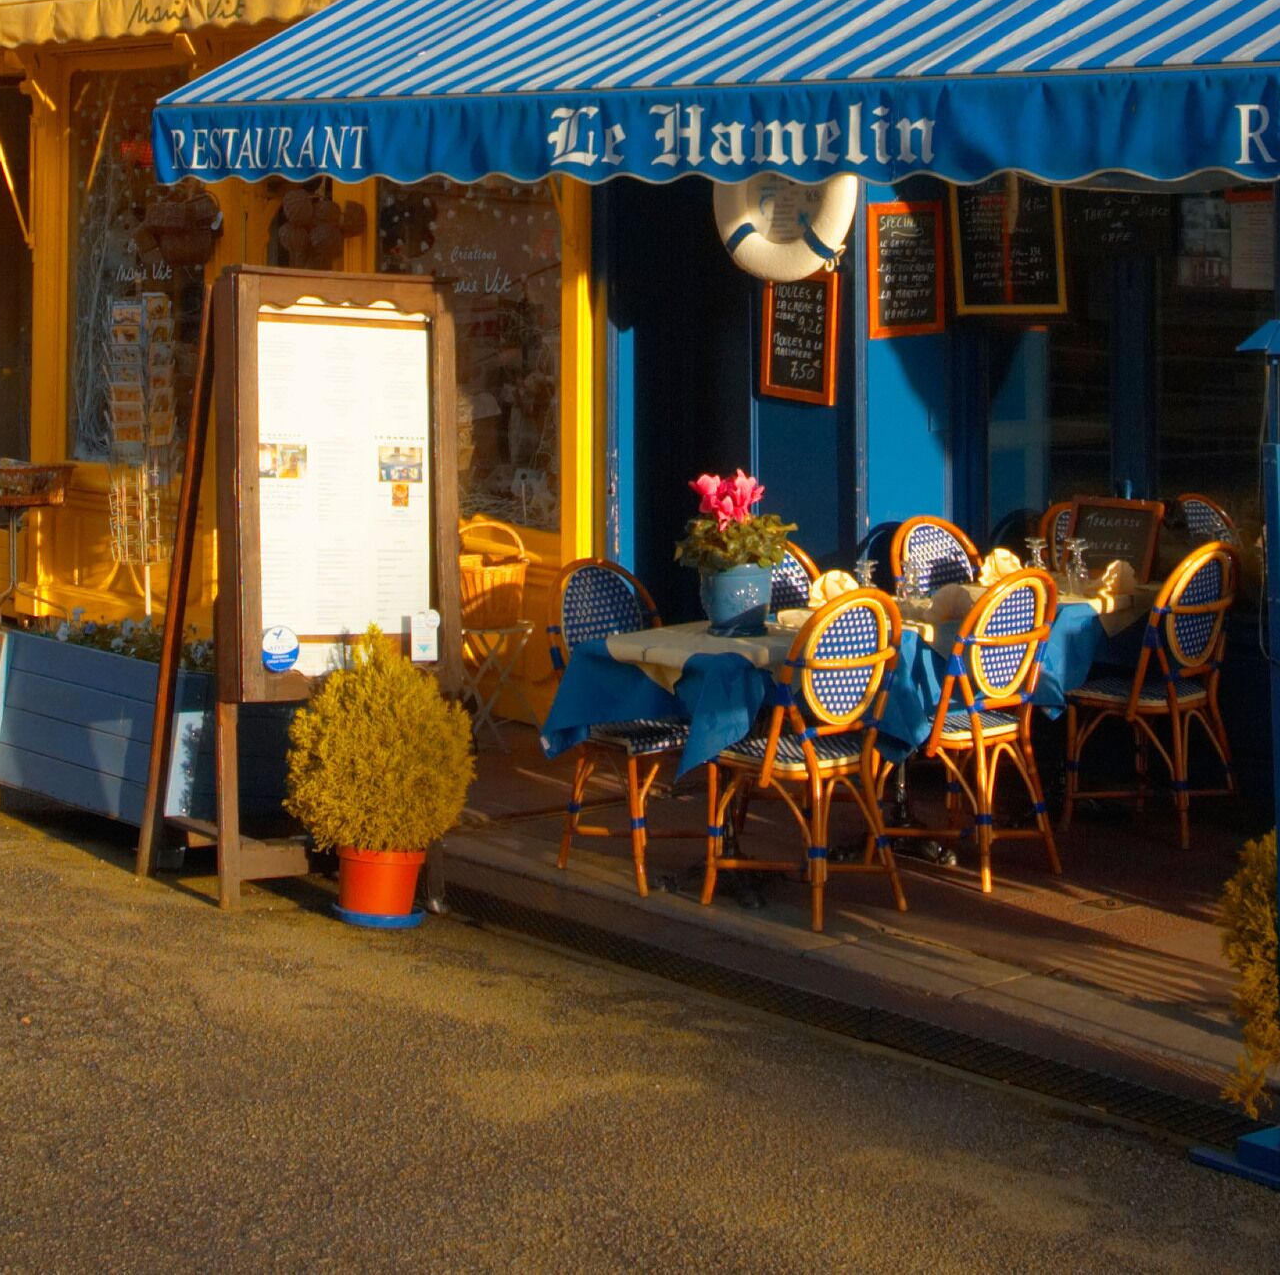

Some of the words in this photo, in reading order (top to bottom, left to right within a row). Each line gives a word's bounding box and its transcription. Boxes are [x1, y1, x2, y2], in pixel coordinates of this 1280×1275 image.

[171, 124, 369, 170] RESTAURANT
[547, 104, 628, 168] Le
[648, 101, 937, 167] Hamelin
